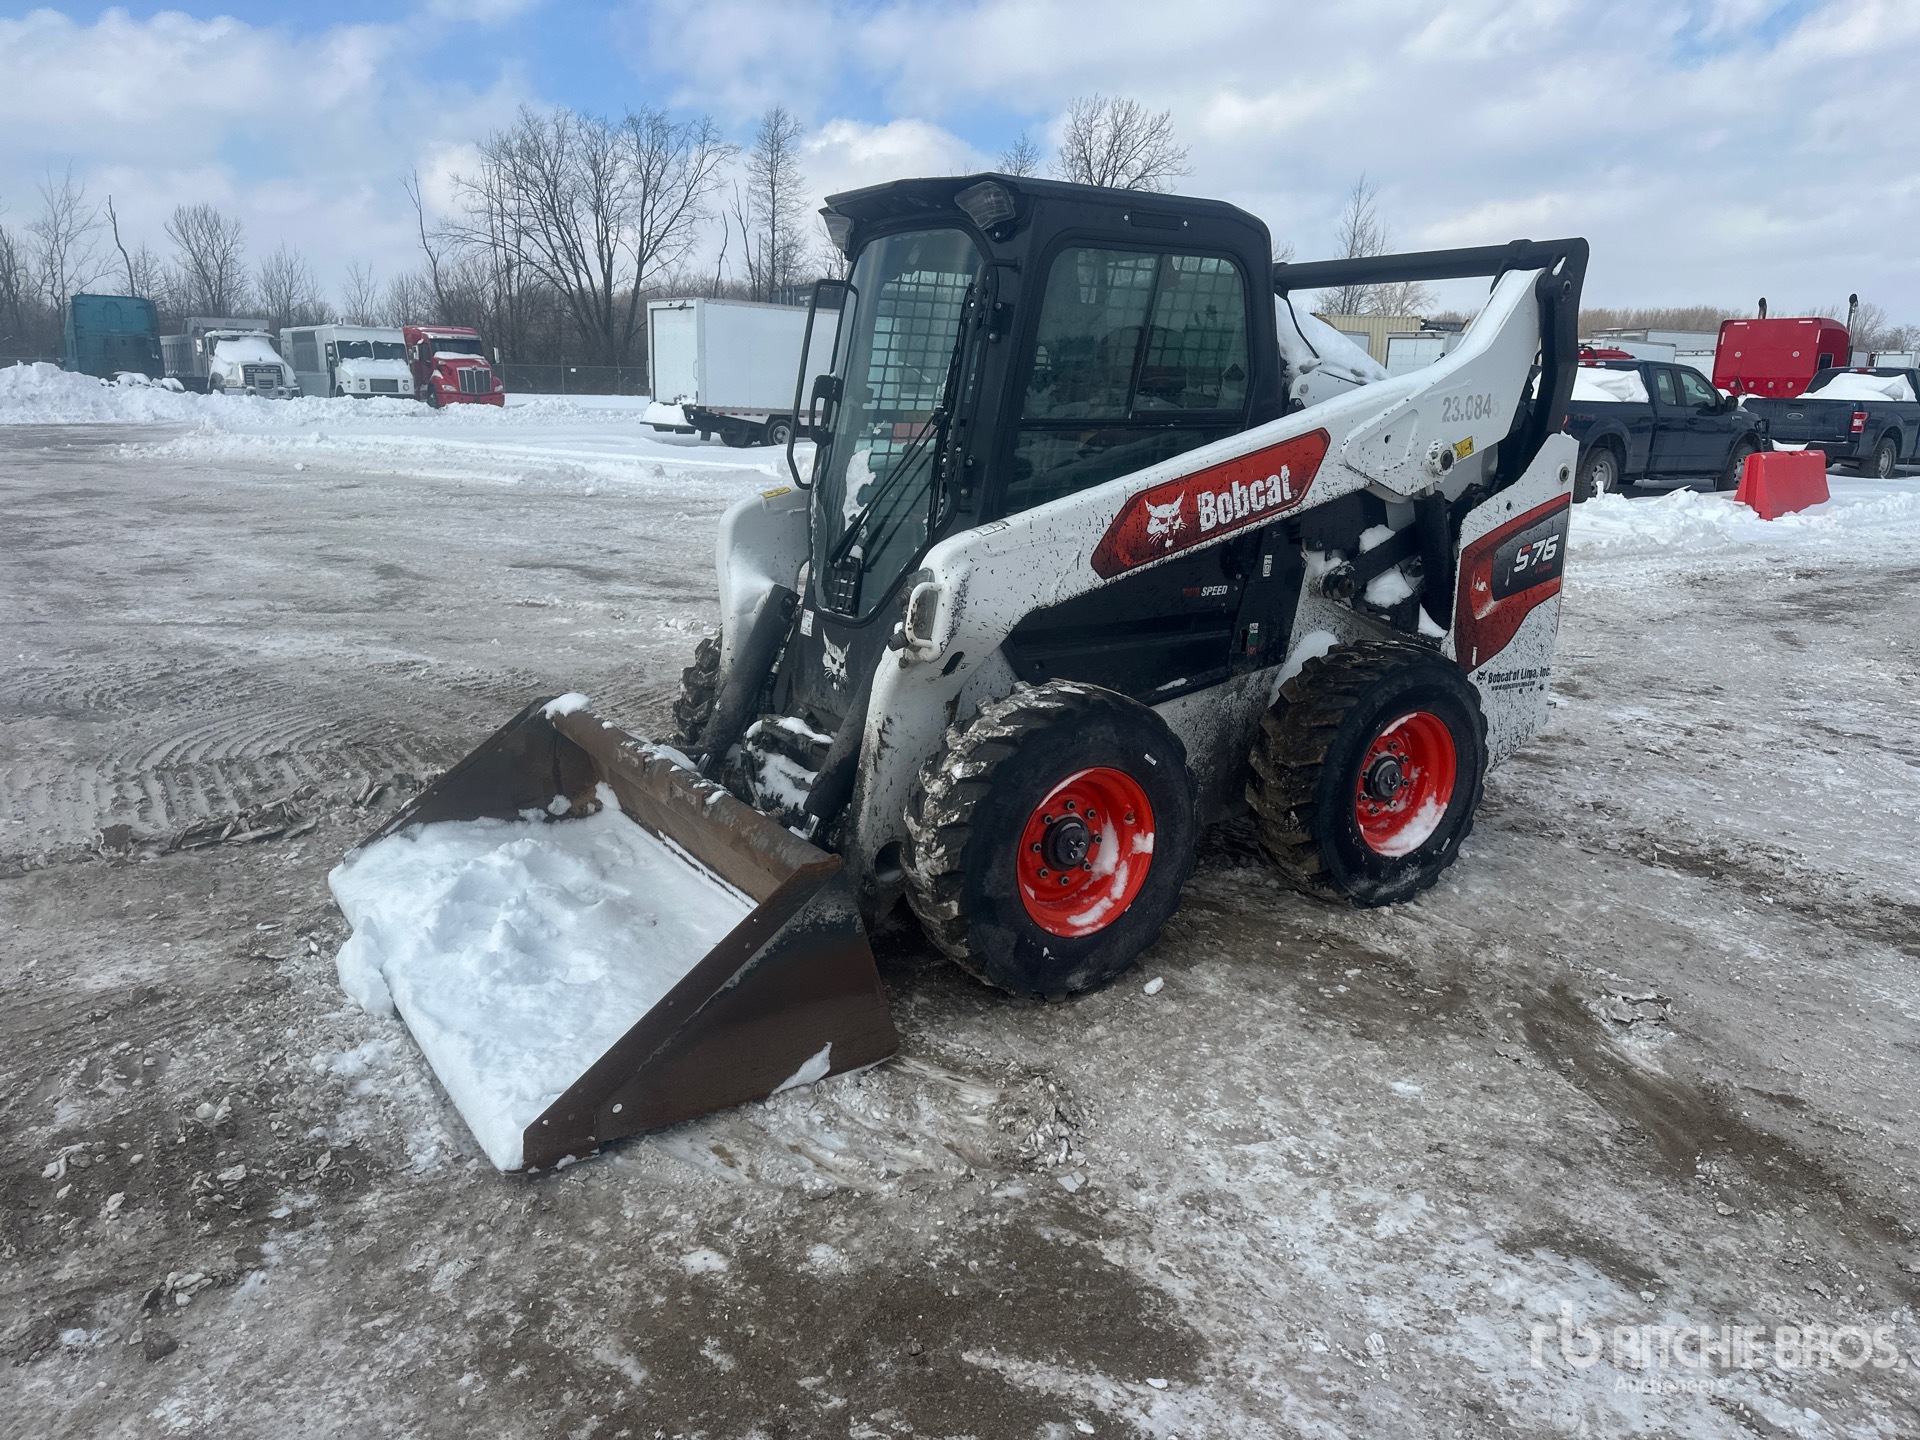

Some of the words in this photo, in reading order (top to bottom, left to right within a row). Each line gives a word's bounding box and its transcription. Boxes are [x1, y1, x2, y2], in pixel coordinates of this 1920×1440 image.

[1197, 464, 1292, 532] Bobcat
[1513, 534, 1560, 573] S76
[1201, 585, 1228, 597] SPEED
[1488, 670, 1513, 684] Bobcat
[1513, 669, 1520, 681] of
